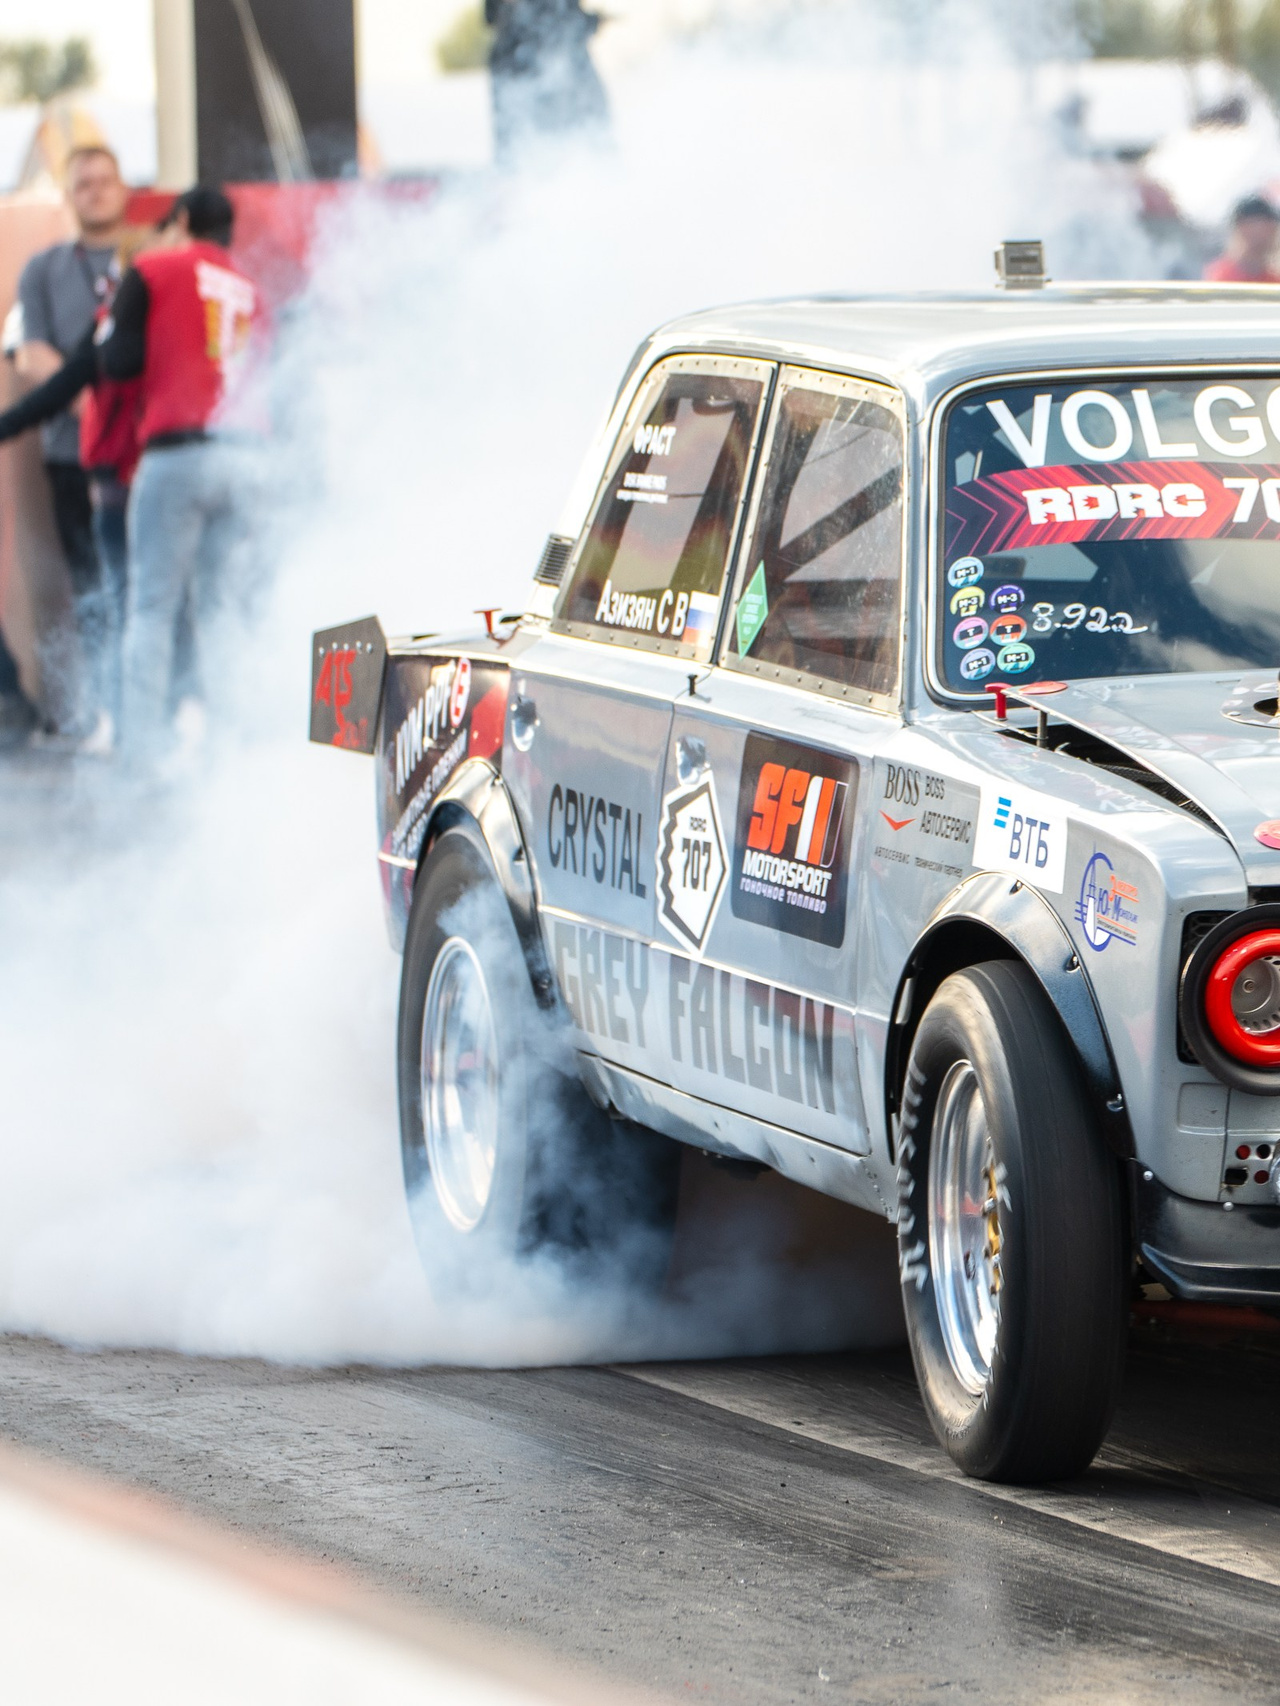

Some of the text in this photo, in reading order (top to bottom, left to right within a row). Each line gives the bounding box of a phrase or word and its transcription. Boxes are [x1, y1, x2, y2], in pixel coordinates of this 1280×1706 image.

[1022, 483, 1208, 525] RDRC
[883, 764, 922, 806] BOSS
[925, 775, 946, 800] BOSS
[547, 783, 647, 899] CRYSTAL
[919, 810, 972, 844] АВТОСЕРВИС
[1009, 813, 1050, 869] ВТБ
[682, 837, 712, 892] 707
[742, 849, 832, 897] MOTORSPORT
[553, 920, 836, 1115] GREY FALCON
